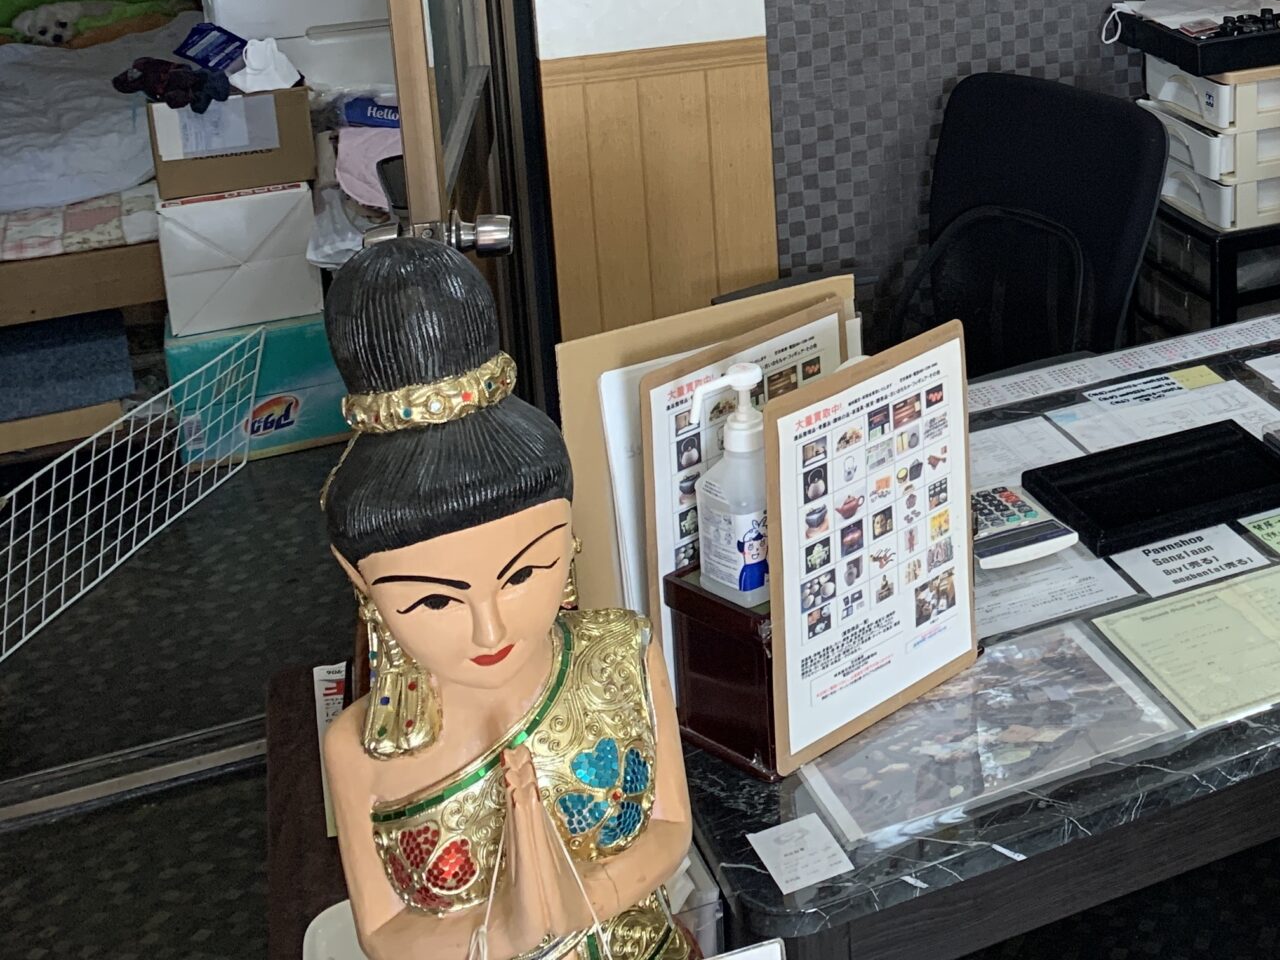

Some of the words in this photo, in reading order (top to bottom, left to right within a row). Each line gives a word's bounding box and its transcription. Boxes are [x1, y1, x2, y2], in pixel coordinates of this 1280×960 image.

[367, 106, 399, 121] Hello
[1142, 535, 1205, 557] Pawnshop
[1151, 544, 1214, 566] Sanglaan
